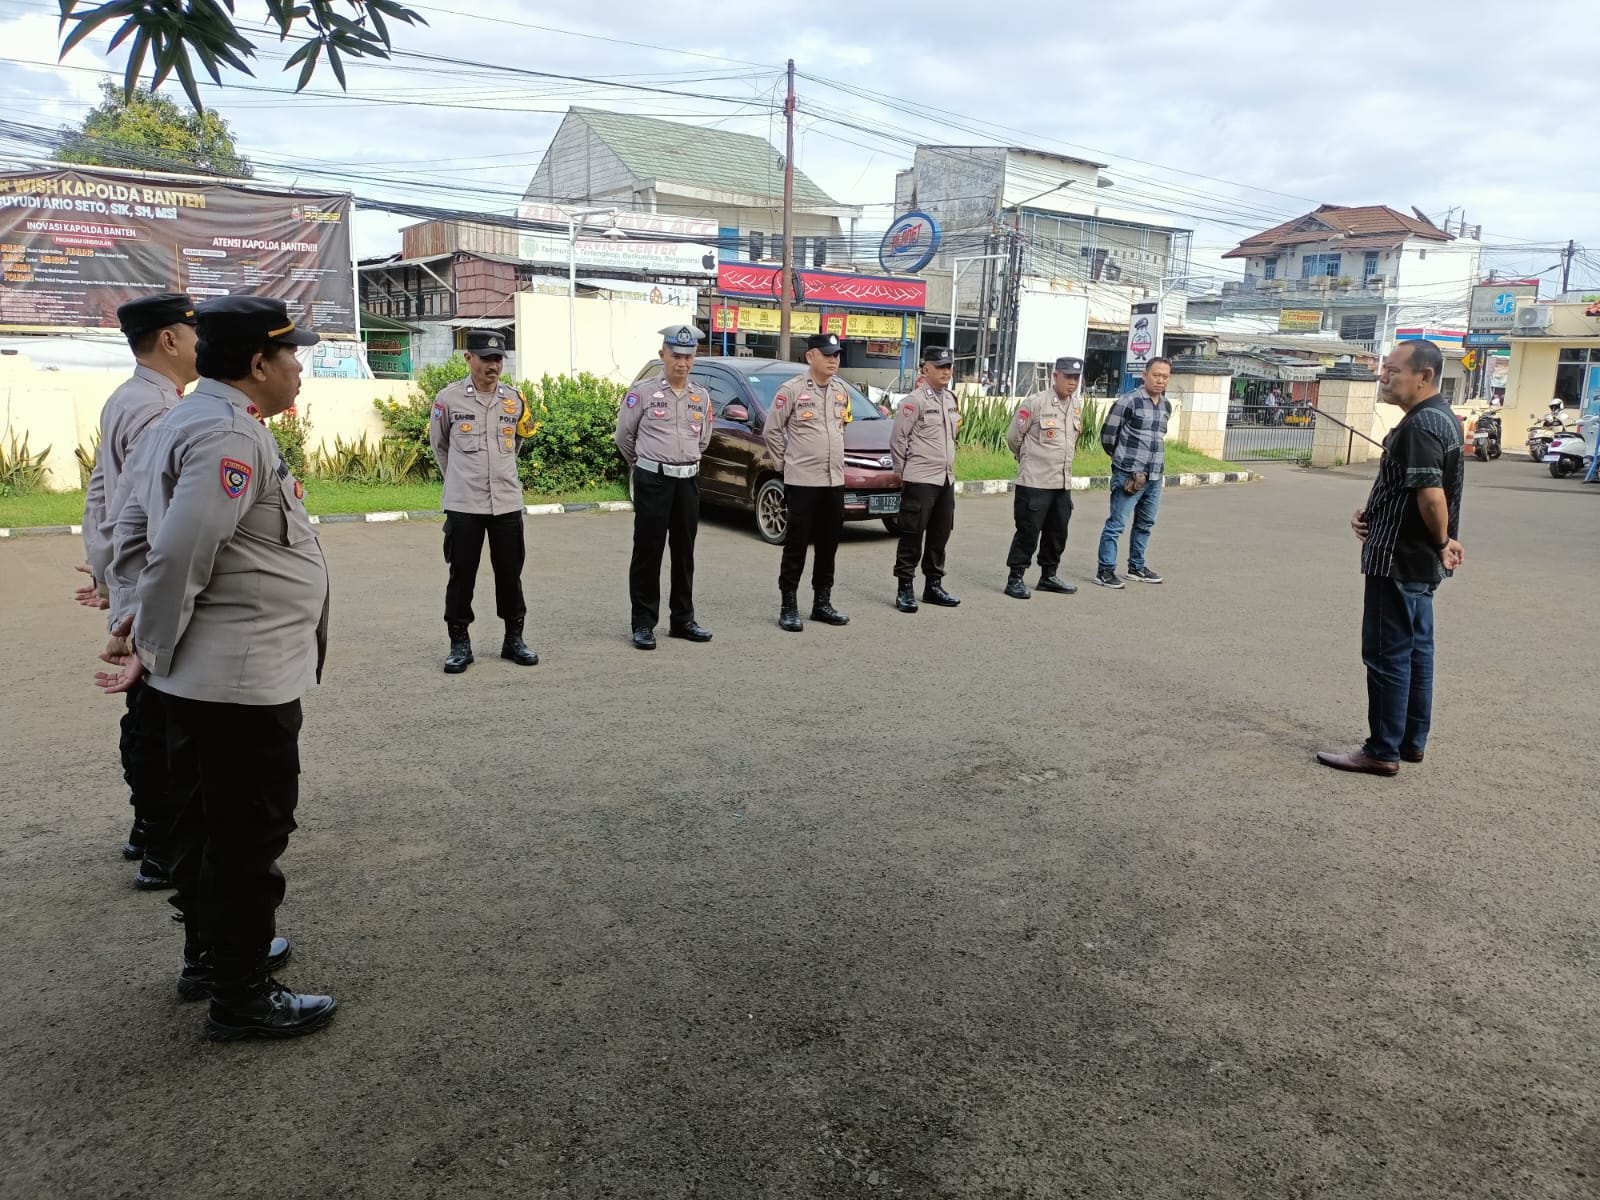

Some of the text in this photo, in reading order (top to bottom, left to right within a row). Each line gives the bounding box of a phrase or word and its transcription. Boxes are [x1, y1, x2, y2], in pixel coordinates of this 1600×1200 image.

[15, 178, 59, 194] WISH
[61, 179, 140, 202] KAPOLDA
[142, 188, 206, 209] BANTEN
[43, 197, 73, 210] ARIO
[75, 199, 109, 216] SETO,
[26, 221, 137, 237] INOVASI KAPOLDA BANTEN
[212, 237, 241, 248] ATENSI
[242, 239, 280, 251] KAPOLDA
